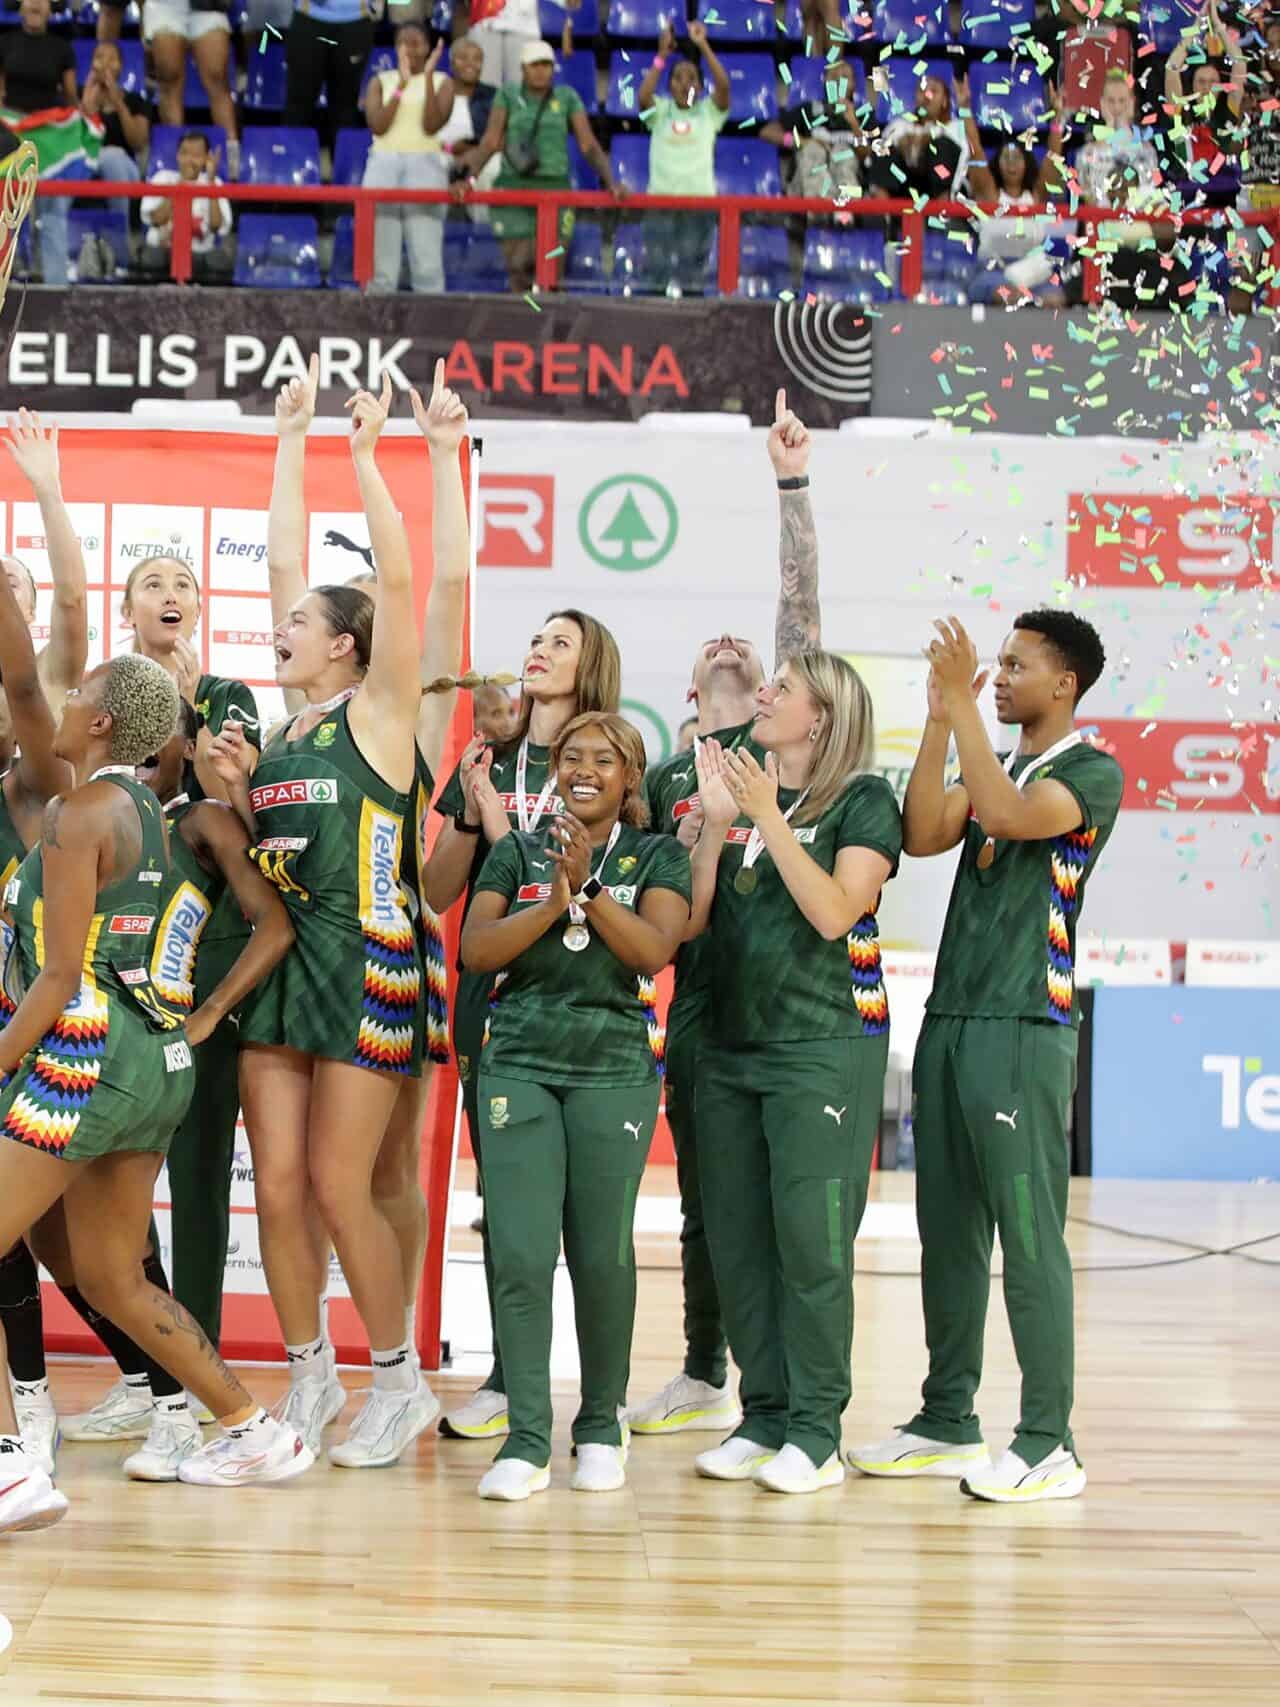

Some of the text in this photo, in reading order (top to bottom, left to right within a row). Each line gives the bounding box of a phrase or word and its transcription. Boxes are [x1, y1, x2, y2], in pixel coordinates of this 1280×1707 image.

[9, 332, 689, 397] ELLIS PARK ARENA
[215, 536, 269, 563] Energ
[252, 784, 306, 807] SPAR
[374, 823, 397, 922] Telkom
[161, 899, 206, 983] Telkom
